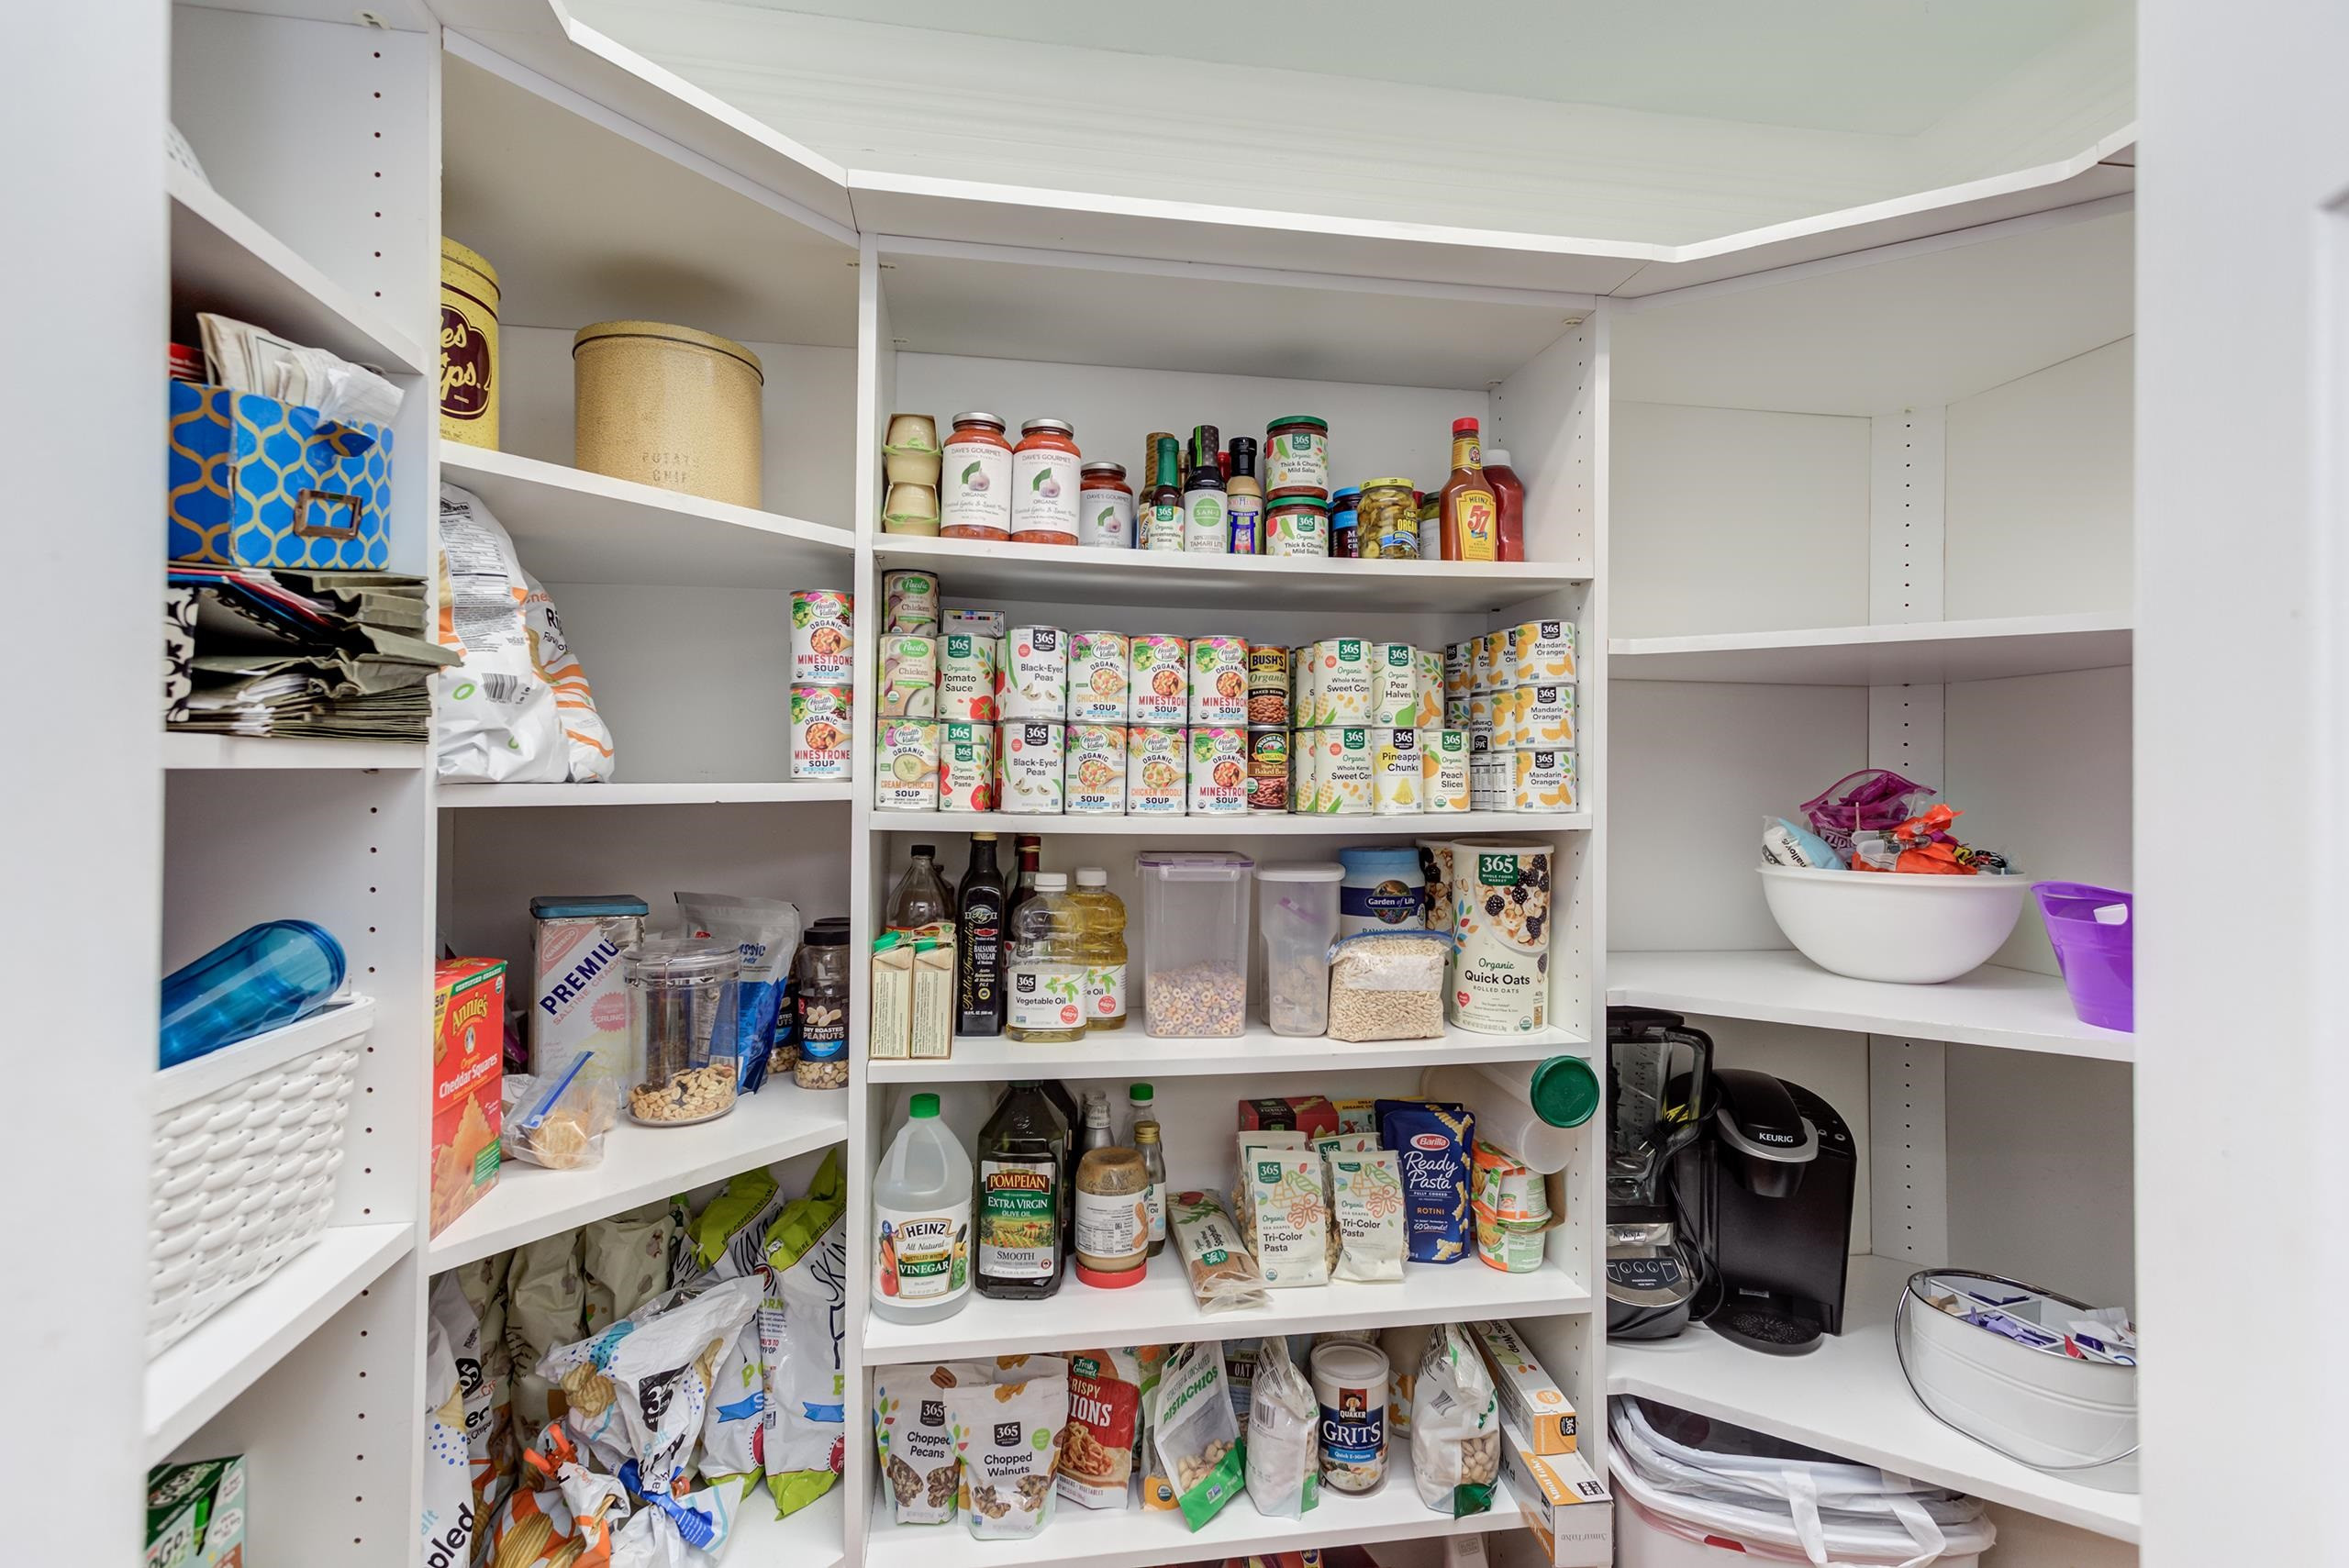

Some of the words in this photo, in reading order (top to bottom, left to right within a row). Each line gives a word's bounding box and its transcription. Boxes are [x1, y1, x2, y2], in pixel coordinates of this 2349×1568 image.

[1294, 435, 1310, 445] 365
[971, 447, 1001, 458] GOURMET
[1041, 454, 1072, 464] GOURMET
[1301, 461, 1321, 469] Chunky
[1469, 496, 1489, 505] HEINZ
[1298, 517, 1314, 526] 365
[1468, 505, 1491, 534] 57
[905, 578, 928, 589] Pacific
[901, 603, 930, 613] Chicken
[1542, 626, 1559, 634] 365
[1034, 632, 1054, 644] 365
[903, 640, 927, 651] Pacific
[949, 639, 969, 651] 365
[1341, 643, 1360, 655] 365
[1389, 649, 1408, 660] 365
[1252, 654, 1284, 667] BUSH'S
[814, 664, 841, 673] SOUP
[898, 667, 929, 676] Chicken
[1020, 663, 1063, 674] Black-Eyed
[943, 673, 977, 683] Tomato
[1034, 673, 1054, 683] Peas
[944, 683, 974, 693] Sauce
[1327, 684, 1353, 693] Sweet
[1390, 681, 1408, 689] Pear
[1538, 690, 1555, 698] 365
[1093, 704, 1117, 712] SOUP
[950, 728, 970, 739] 365
[1026, 727, 1047, 739] 365
[1345, 732, 1364, 743] 365
[1395, 732, 1413, 743] 365
[1443, 735, 1462, 745] 365
[794, 750, 851, 760] MINESTRONE
[956, 747, 972, 757] 365
[1013, 758, 1058, 768] Black-Eyed
[1536, 755, 1553, 763] 365
[1026, 767, 1046, 776] Peas
[1386, 762, 1419, 772] Chunks
[1331, 773, 1357, 781] Sweet
[1441, 771, 1464, 780] Peach
[1441, 780, 1464, 788] Slices
[1080, 795, 1105, 803] SOUP
[1145, 796, 1170, 805] SOUP
[1482, 856, 1514, 873] 365
[1367, 897, 1396, 906] Garden
[1396, 897, 1404, 906] of
[1404, 897, 1416, 906] Life
[544, 929, 576, 961] NABISCO
[974, 945, 997, 953] BALSAMIC
[974, 952, 996, 961] VINEGAR
[1478, 958, 1516, 971] Organic
[540, 938, 620, 1017] PREMIU
[1018, 976, 1034, 987] 365
[1464, 970, 1499, 984] Quick
[1501, 973, 1531, 985] Oats
[552, 988, 590, 1026] SALTINE
[591, 955, 622, 988] CRACK
[1473, 984, 1499, 994] ROLLED
[1015, 996, 1054, 1006] Vegetable
[1054, 996, 1066, 1005] Oil
[452, 992, 489, 1037] Annie's
[803, 1032, 845, 1040] PEANUTS
[439, 1069, 473, 1099] Cheddar
[472, 1053, 498, 1081] Squares
[1419, 1137, 1447, 1147] Barilla
[1759, 1132, 1794, 1143] KEURIG
[1404, 1151, 1459, 1177] Ready
[1260, 1164, 1279, 1177] 365
[990, 1174, 1046, 1188] POMPEIAN
[1408, 1170, 1452, 1190] Pasta
[987, 1195, 1015, 1208] EXTRA
[1016, 1198, 1048, 1209] VIRGIN
[1341, 1200, 1364, 1209] Organic
[1417, 1207, 1445, 1216] ROTINI
[1262, 1215, 1286, 1224] Organic
[1341, 1218, 1381, 1229] Tri-Color
[906, 1223, 946, 1238] HEINZ
[1413, 1223, 1423, 1231] 60
[1423, 1222, 1448, 1231] Seconds!
[1264, 1232, 1303, 1242] Tri-Color
[1341, 1229, 1365, 1238] Pasta
[1264, 1243, 1288, 1252] Pasta
[906, 1253, 930, 1262] DISTILLED
[996, 1251, 1035, 1261] SMOOTH
[899, 1261, 949, 1274] VINEGAR
[1502, 1332, 1520, 1354] Wrap
[1077, 1358, 1094, 1371] Fresh
[1073, 1364, 1098, 1377] Gourmet
[1234, 1363, 1252, 1377] OAT
[1072, 1378, 1101, 1398] RISPY
[1163, 1365, 1219, 1425] PISTACHIOS
[923, 1404, 944, 1418] 365
[1069, 1394, 1113, 1428] IONS
[1340, 1410, 1366, 1419] QUAKER
[996, 1426, 1019, 1439] 365
[1322, 1419, 1382, 1446] GRITS
[909, 1445, 945, 1459] Pecans
[984, 1451, 1033, 1467] Chopped
[987, 1465, 1030, 1477] Walnuts
